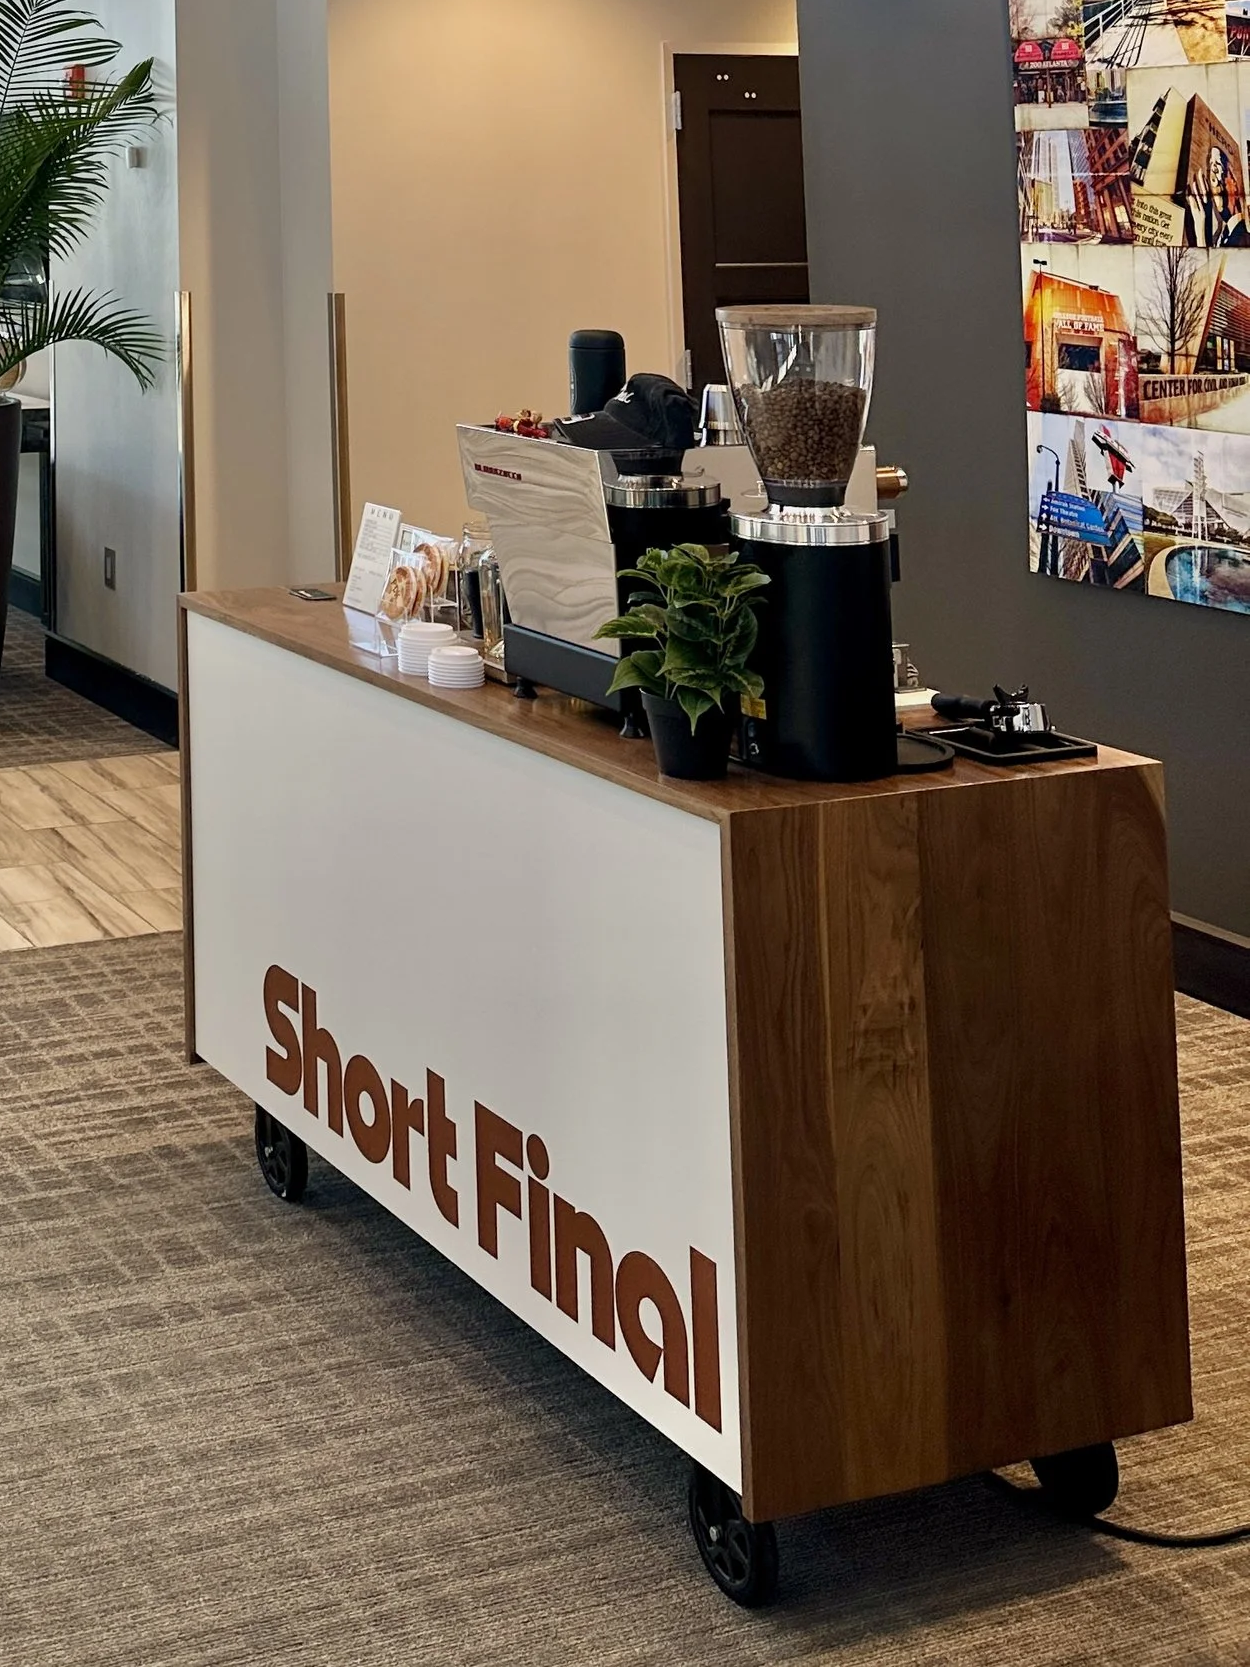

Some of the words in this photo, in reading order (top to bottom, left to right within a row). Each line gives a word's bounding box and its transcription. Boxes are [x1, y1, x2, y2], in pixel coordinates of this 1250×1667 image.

[1143, 379, 1186, 401] CENTER
[1187, 378, 1203, 396] FOR
[263, 964, 460, 1230] Short
[474, 1099, 723, 1436] Final
